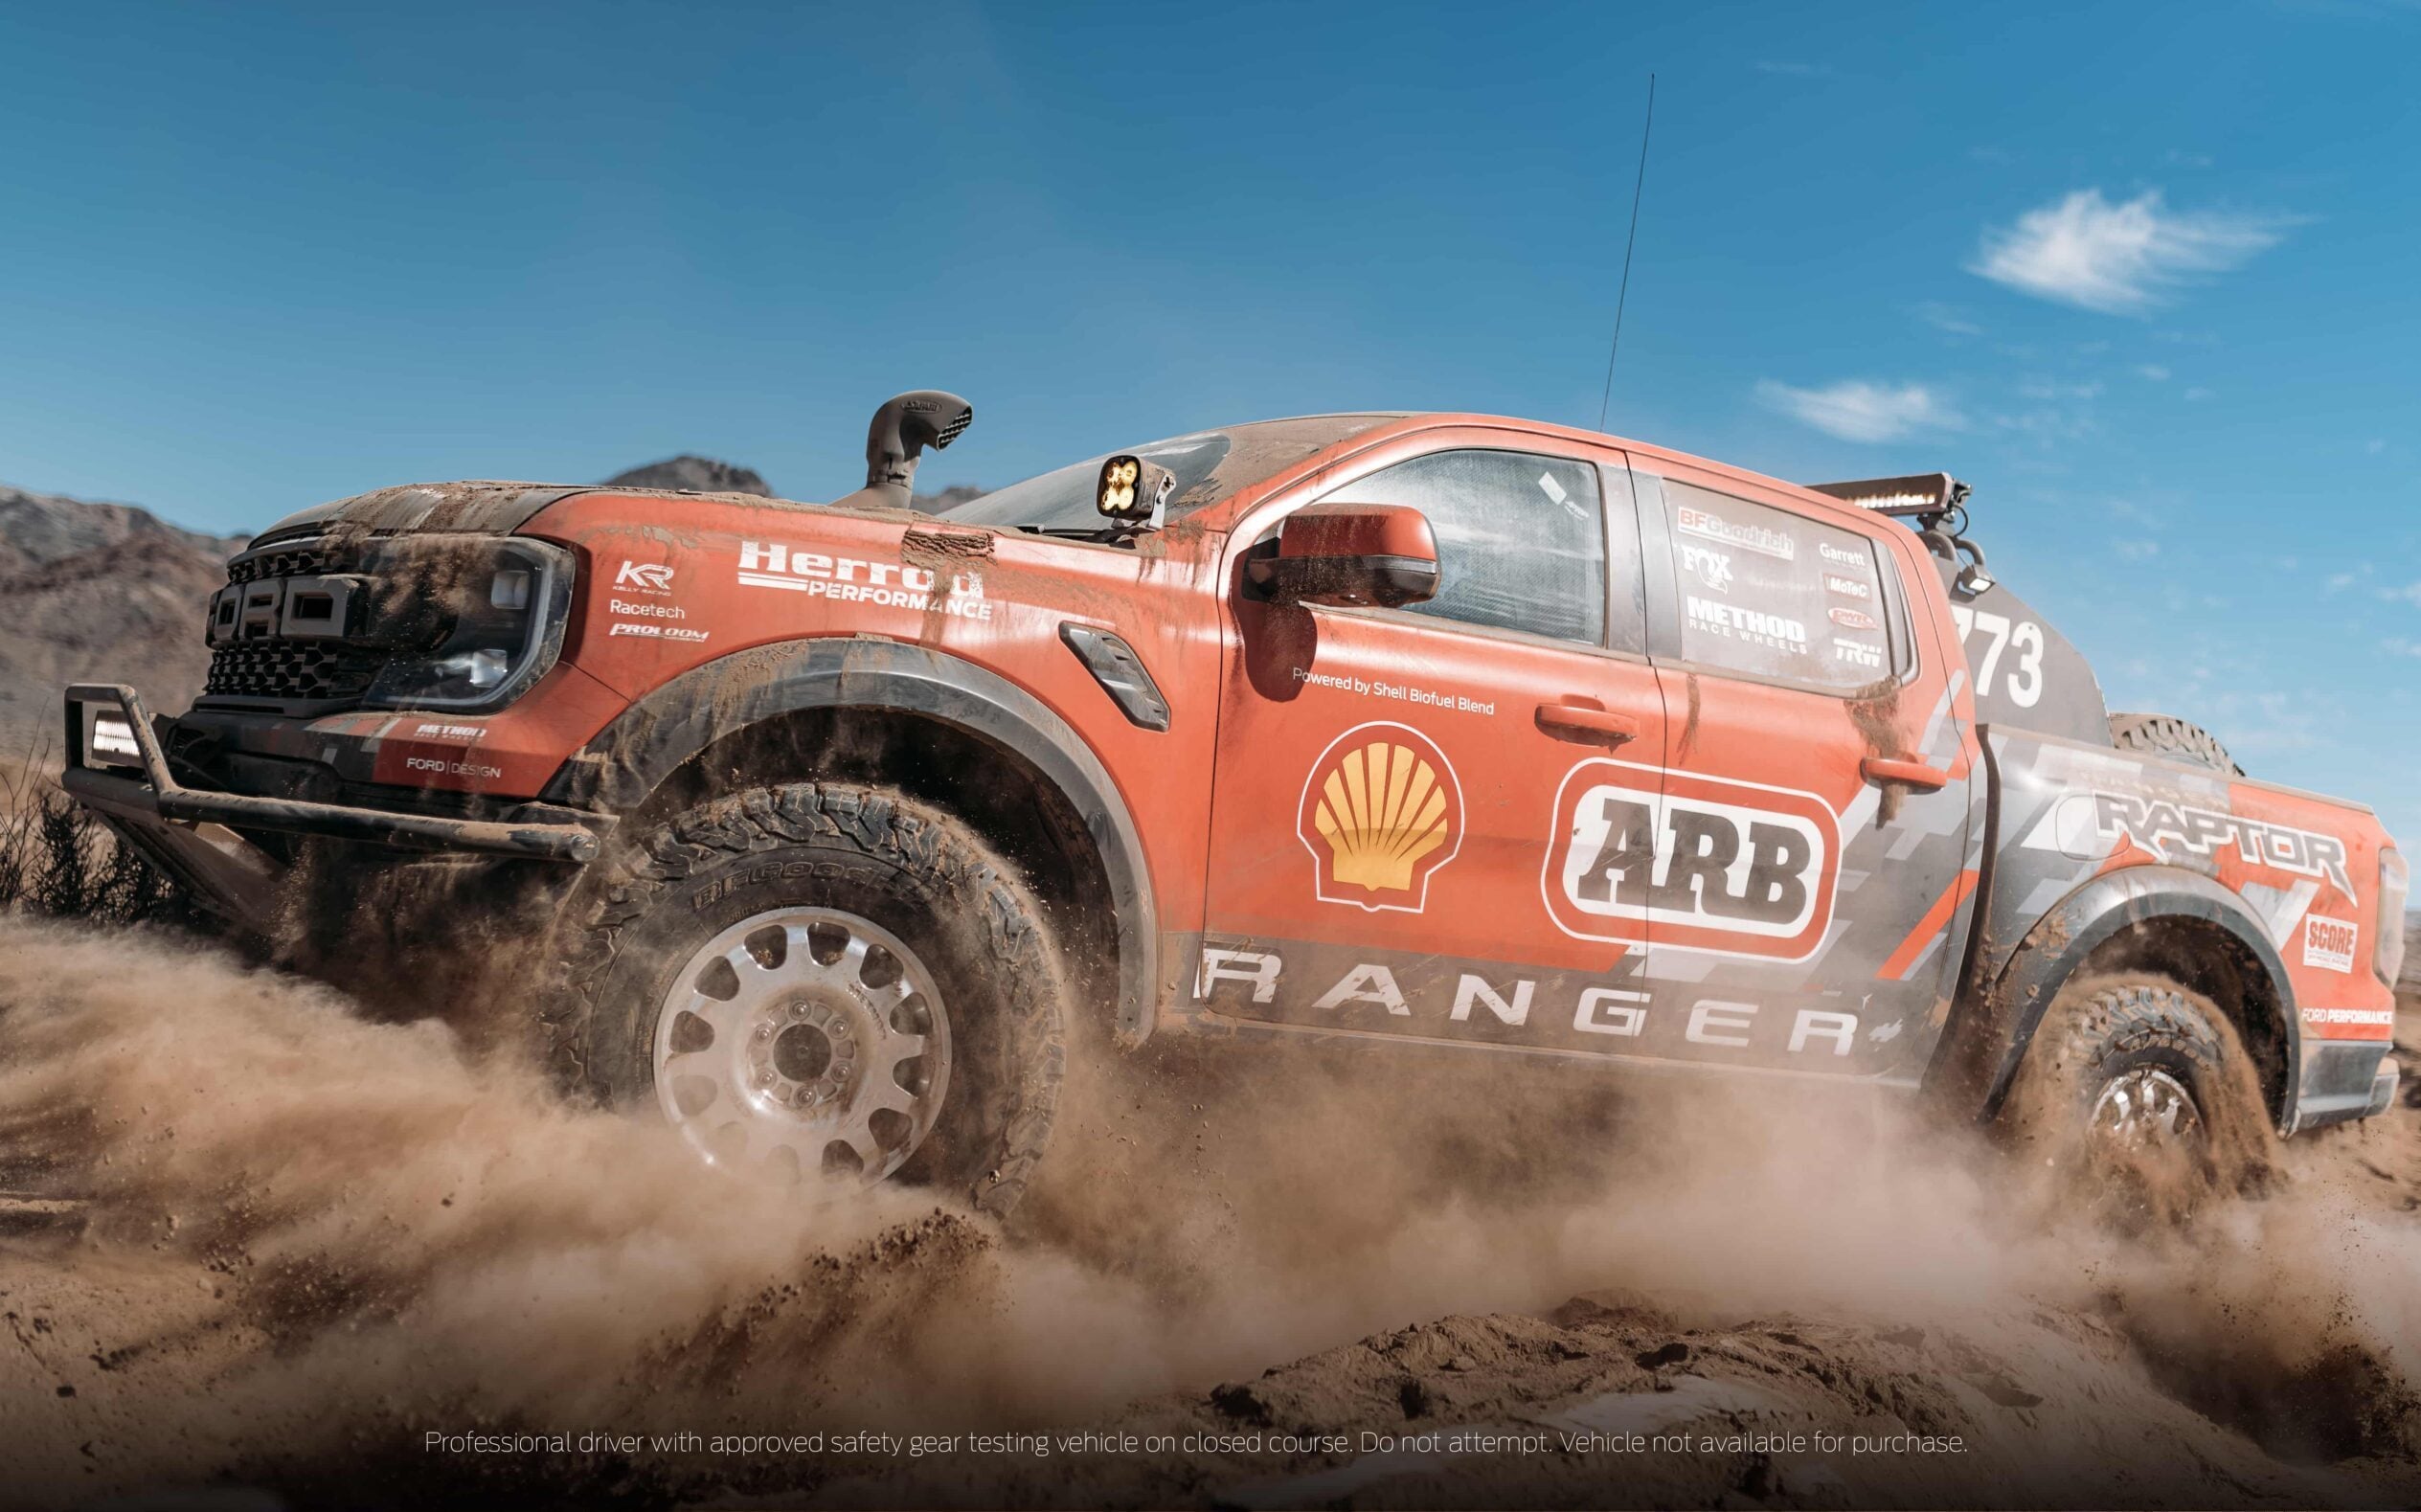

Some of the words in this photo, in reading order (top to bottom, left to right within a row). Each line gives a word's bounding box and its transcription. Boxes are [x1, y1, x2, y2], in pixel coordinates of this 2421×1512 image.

[1679, 508, 1795, 553] BFGoodrich
[1682, 544, 1733, 582] FOX
[1820, 542, 1866, 567] Garrett
[615, 560, 674, 590] KR
[1830, 576, 1868, 598] MoTeC
[610, 599, 686, 619] Racetech
[807, 580, 993, 621] PERFORMANCE
[1686, 596, 1806, 643] METHOD
[1688, 618, 1731, 638] RACE
[1739, 630, 1808, 654] WHEELS
[1833, 637, 1882, 668] TRW
[1293, 667, 1351, 690] Powered
[1354, 677, 1370, 696] by
[1373, 682, 1407, 701] Shell
[1410, 688, 1456, 710] Biofuel
[1458, 698, 1494, 716] Blend
[406, 757, 445, 773] FORD
[451, 762, 502, 779] DESIGN
[1577, 798, 1811, 925] ARB
[2092, 789, 2359, 909] RAPTOR
[2308, 921, 2355, 956] SCORE
[1192, 949, 1860, 1056] RANGER
[2302, 1007, 2326, 1023] FORD
